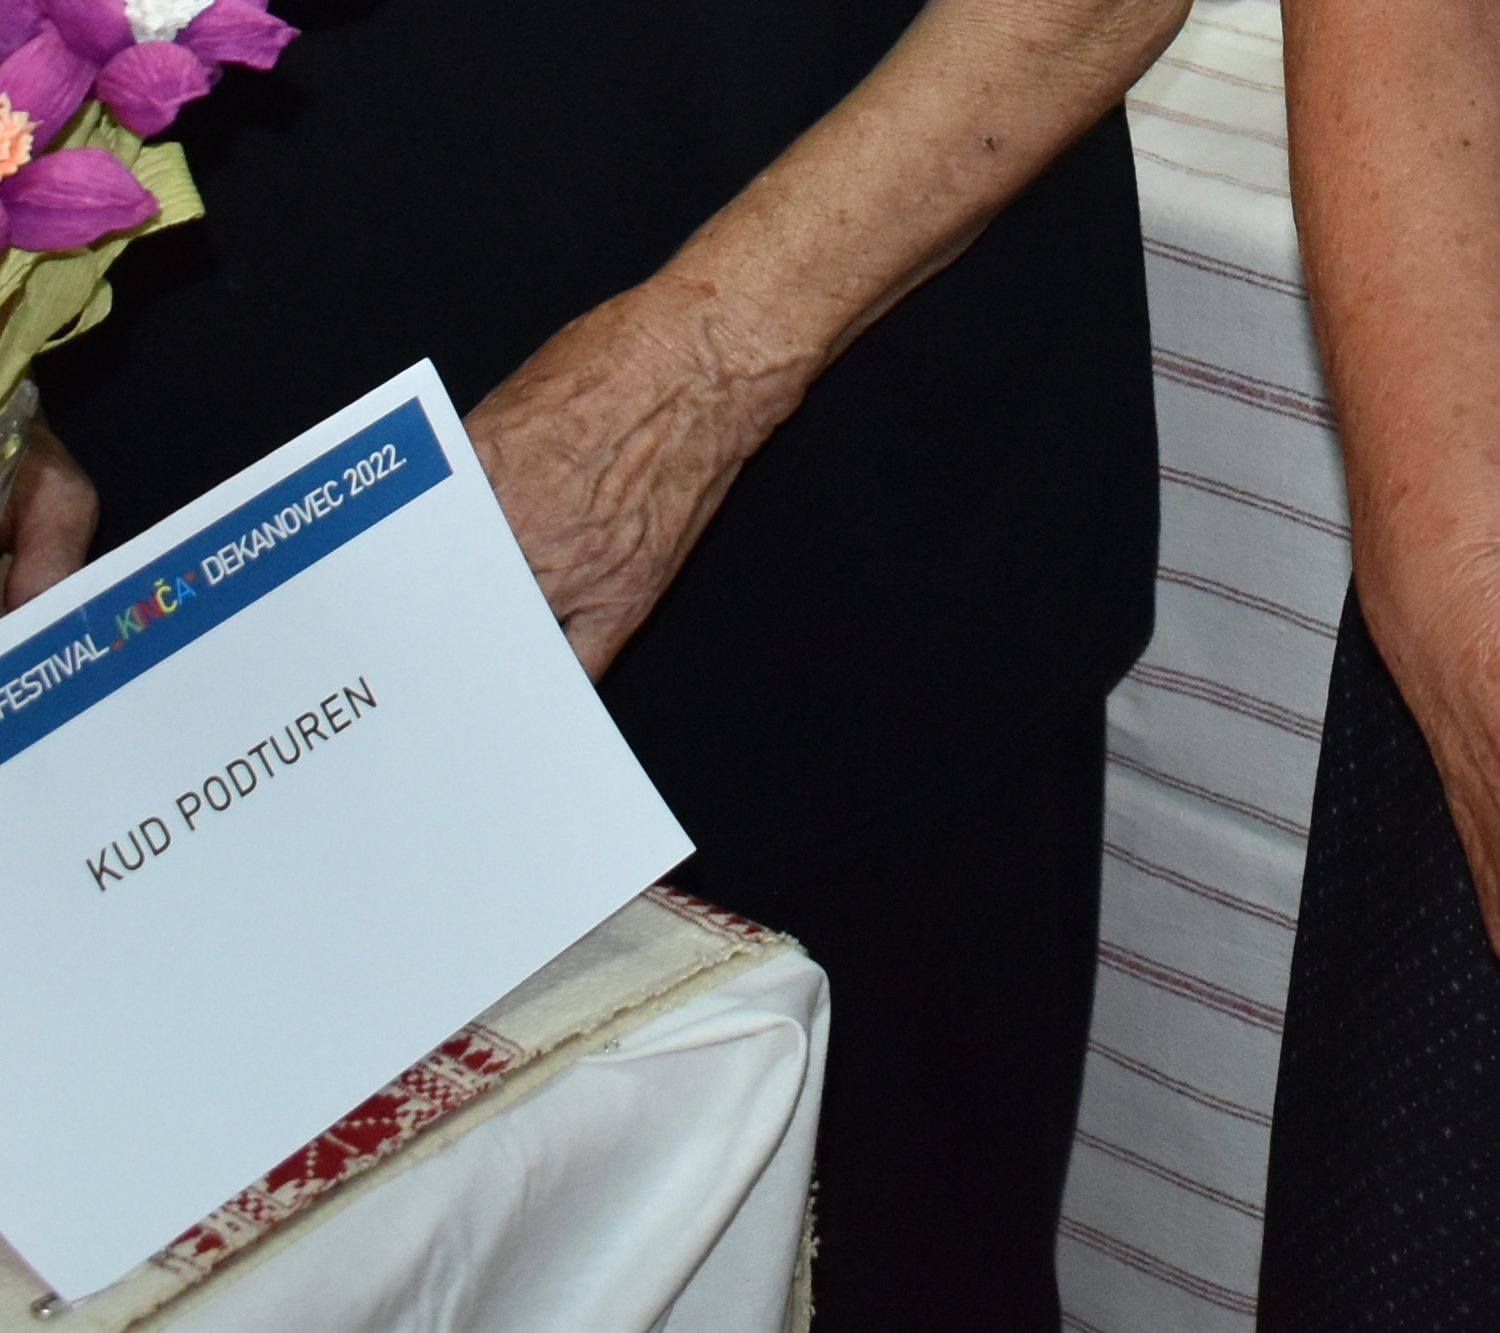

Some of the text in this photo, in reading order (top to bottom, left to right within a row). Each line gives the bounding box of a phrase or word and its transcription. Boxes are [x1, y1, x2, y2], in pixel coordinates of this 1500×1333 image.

[201, 479, 345, 586] DEKANOVEC
[343, 443, 408, 497] 2022.
[86, 674, 379, 892] KUD PODTUREN
